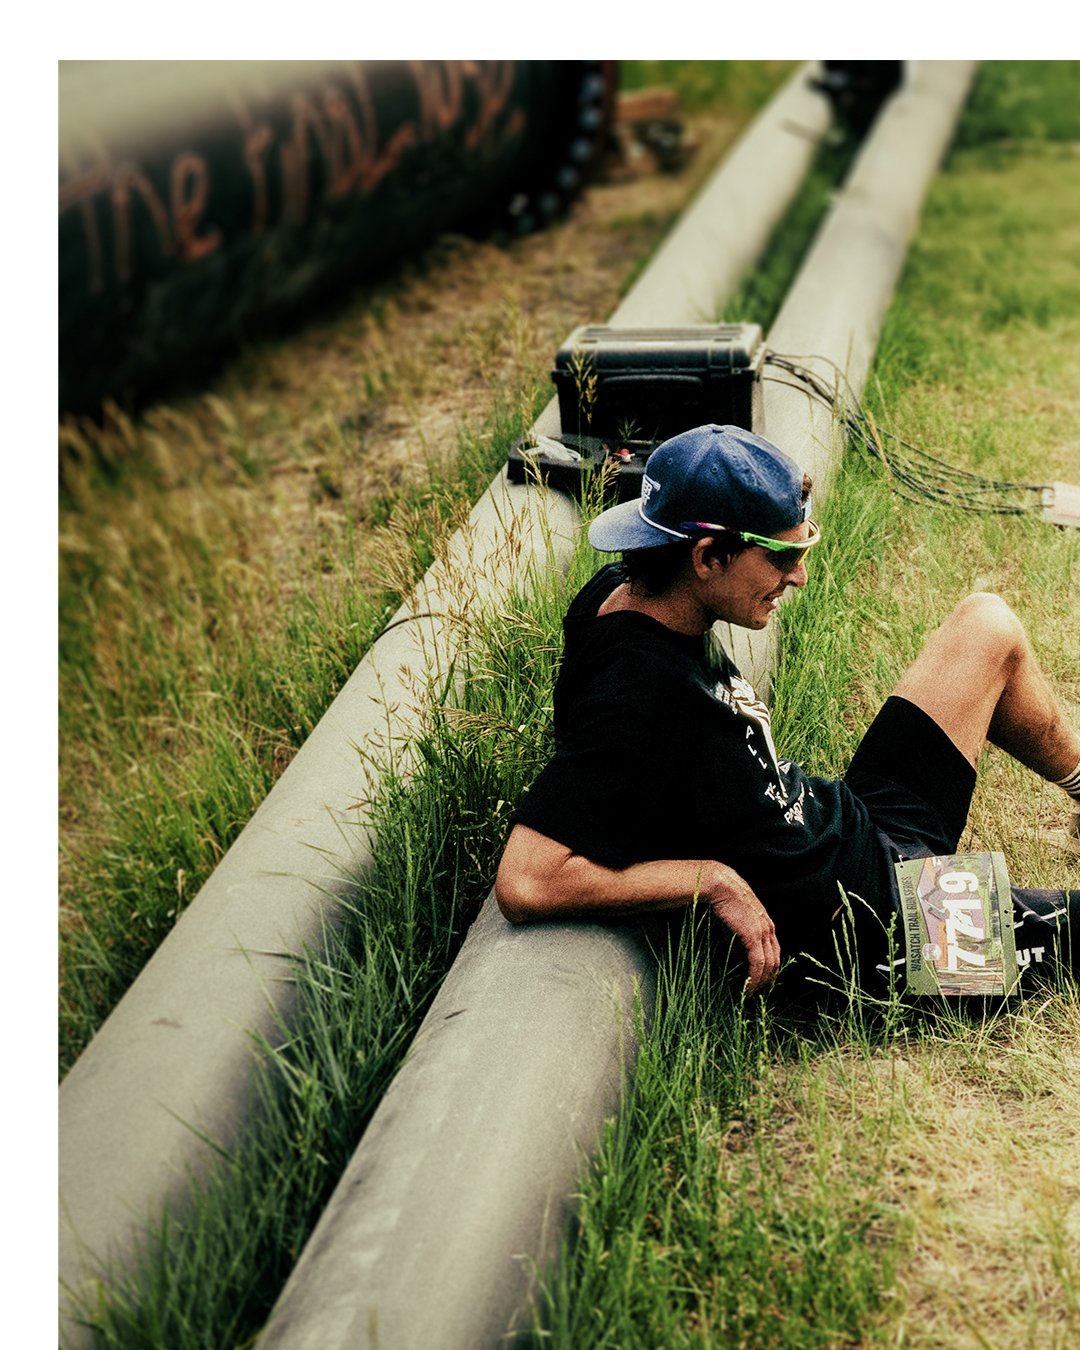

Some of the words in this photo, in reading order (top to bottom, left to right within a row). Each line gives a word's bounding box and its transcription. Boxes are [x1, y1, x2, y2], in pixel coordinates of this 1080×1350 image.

[907, 910, 920, 932] TRAIL
[939, 872, 986, 971] 7719
[909, 932, 922, 972] WASATCH
